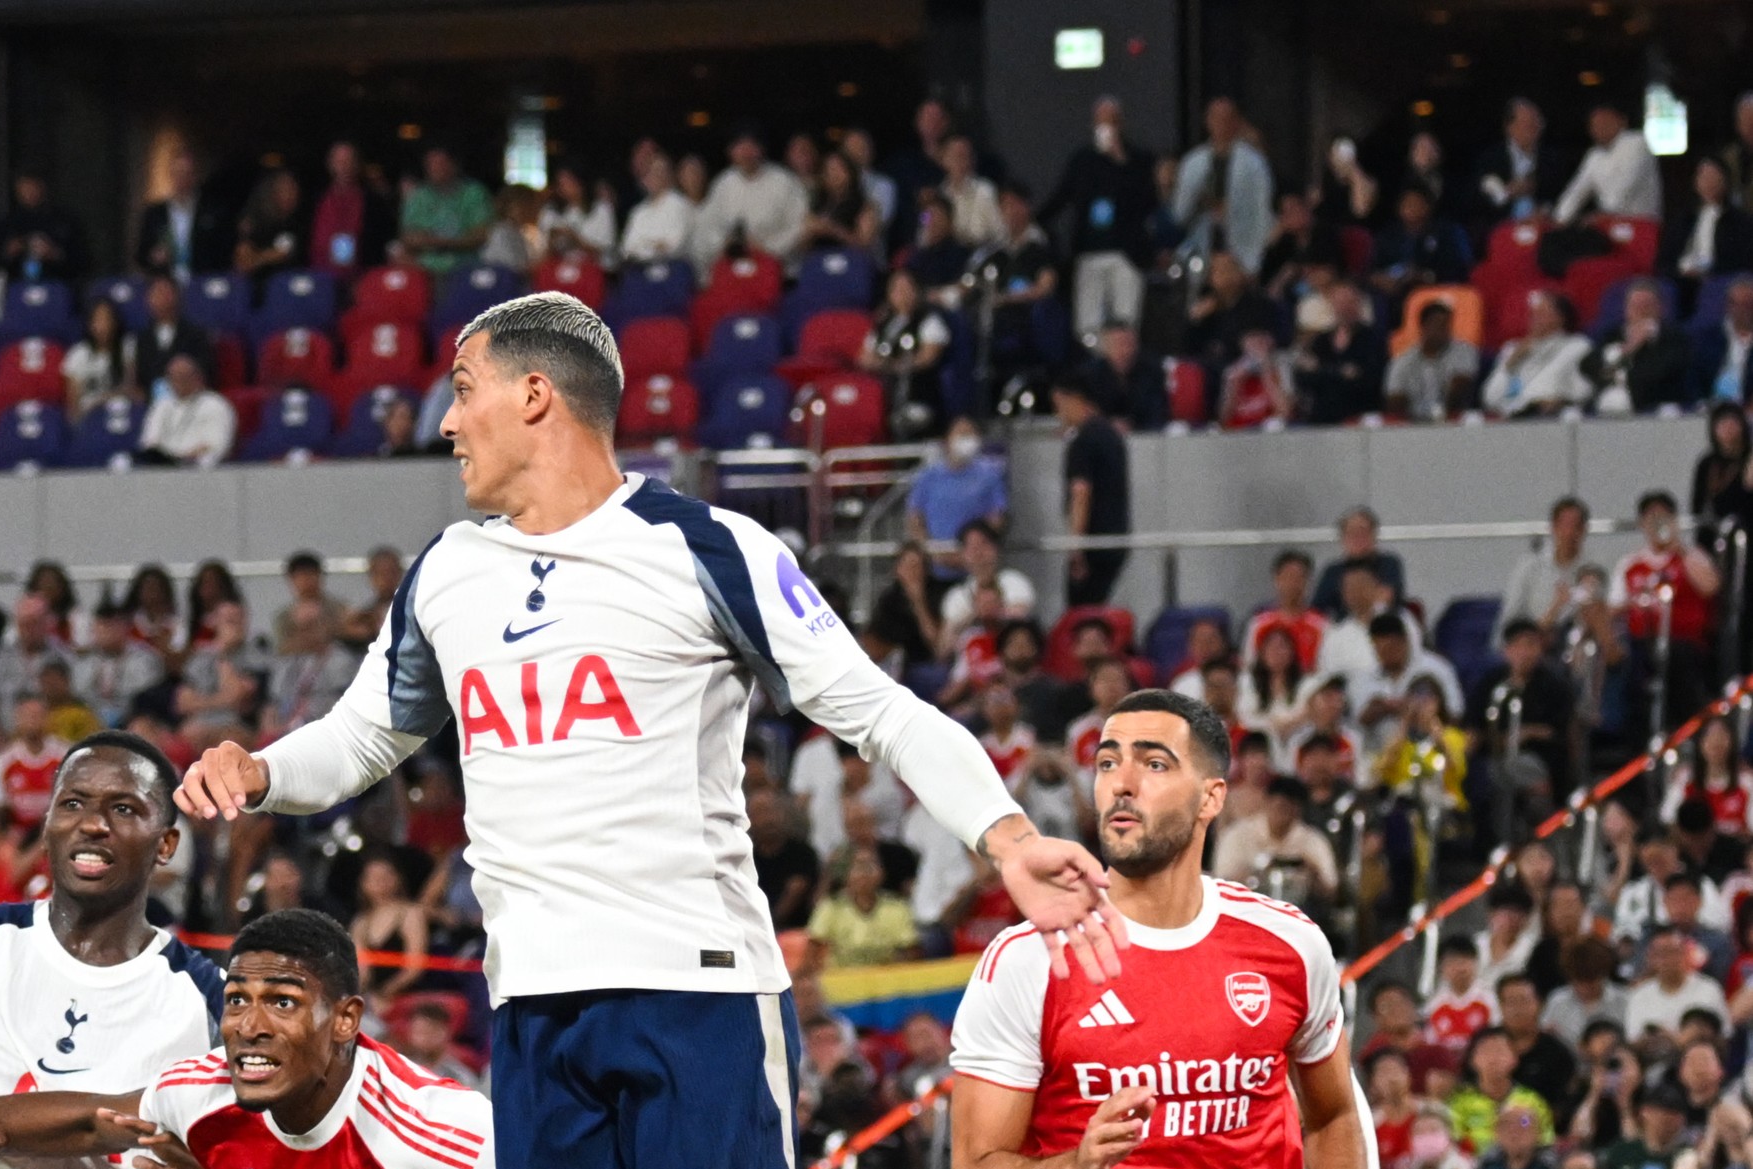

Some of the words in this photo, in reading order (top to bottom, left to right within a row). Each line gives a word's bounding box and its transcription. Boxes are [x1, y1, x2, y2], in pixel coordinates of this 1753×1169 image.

[805, 611, 838, 637] kra
[461, 654, 643, 756] AIA
[1072, 1051, 1276, 1101] Emirates
[1163, 1095, 1251, 1137] BETTER
